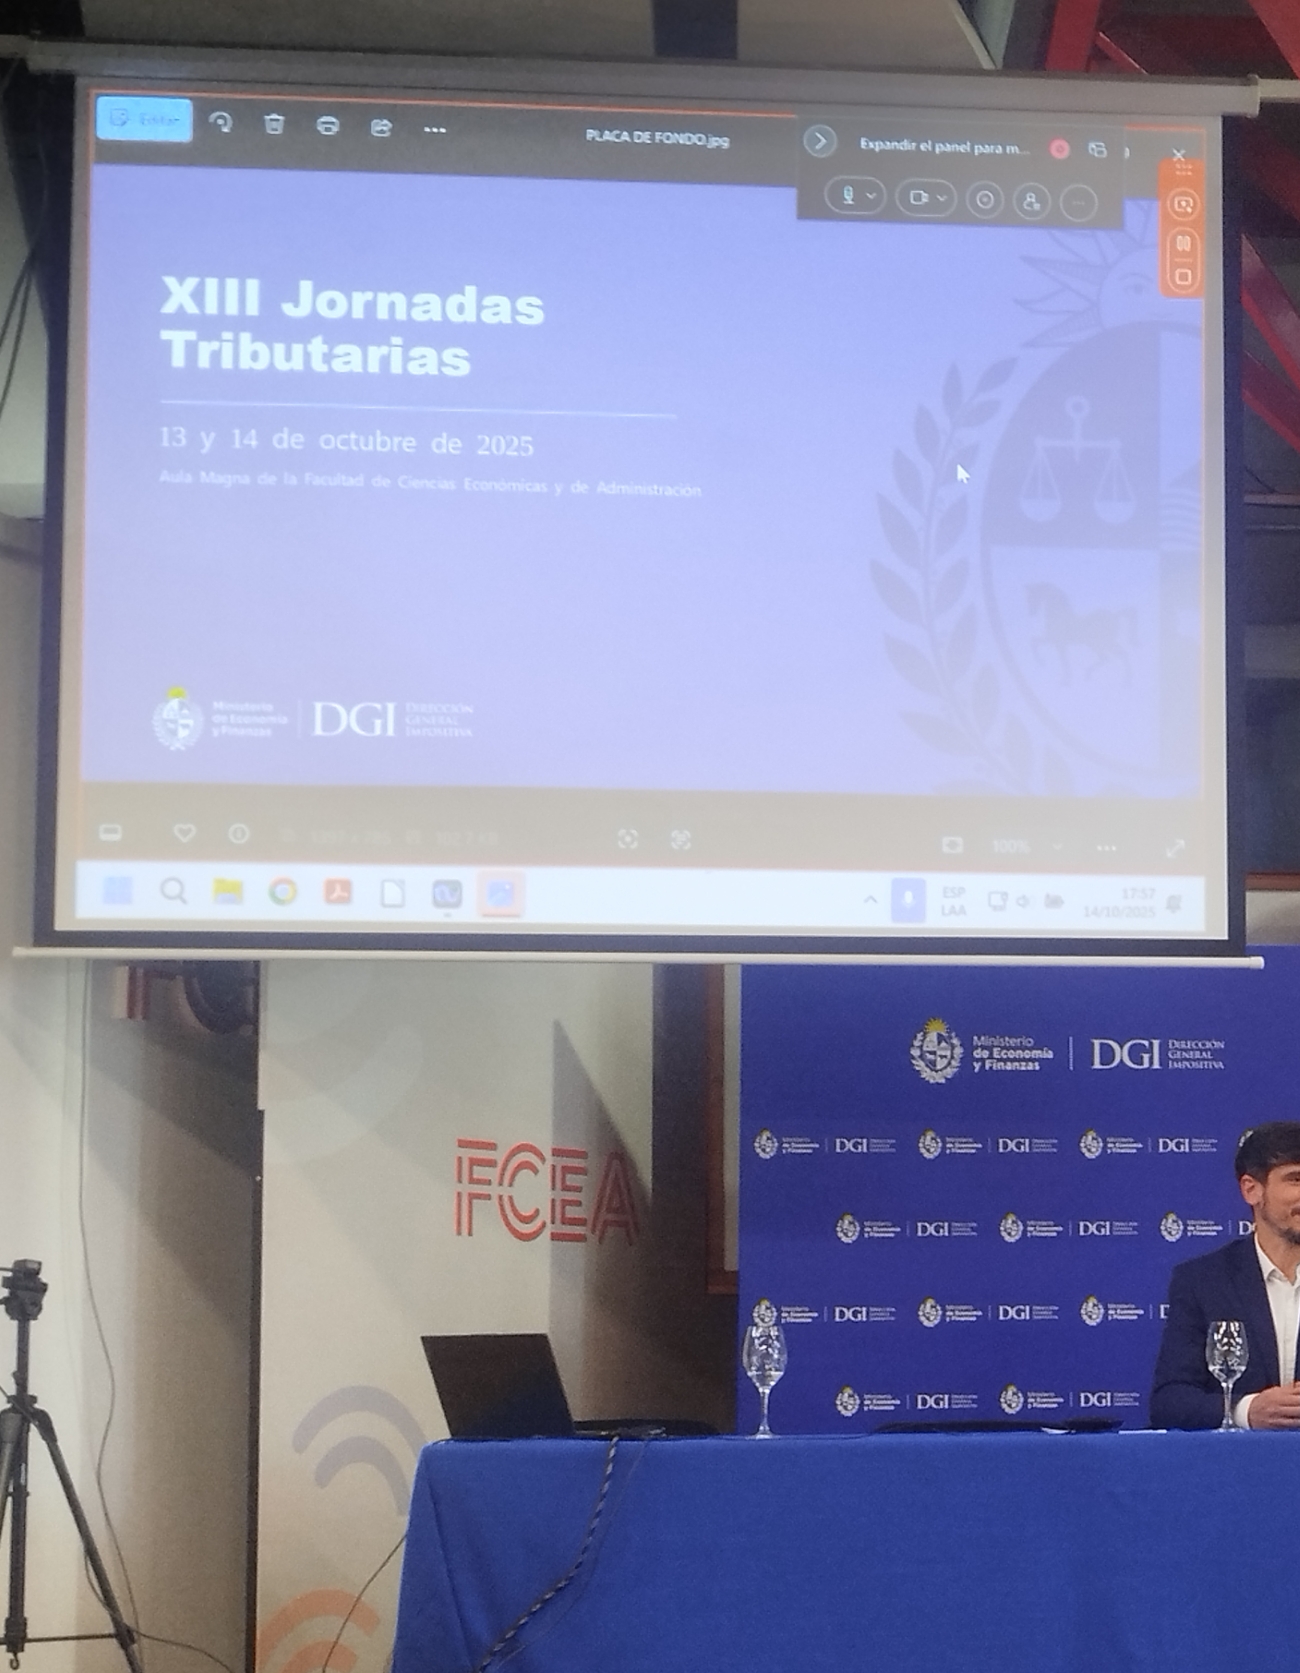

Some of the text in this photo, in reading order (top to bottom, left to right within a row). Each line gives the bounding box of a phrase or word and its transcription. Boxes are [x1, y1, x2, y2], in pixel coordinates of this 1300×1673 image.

[586, 129, 730, 149] PLACA DE FONDO.jpg
[860, 137, 916, 153] Expandir
[920, 140, 932, 152] el
[935, 141, 971, 154] panel
[974, 144, 1003, 156] para
[160, 276, 545, 326] XIII Jornadas
[160, 330, 472, 377] Tributarias
[160, 426, 534, 457] 13 y 14 de octubre de 2025
[158, 469, 701, 497] Aula Magna de la Facultad de Ciencias Económicas y de Administración
[213, 701, 274, 712] Ministerio
[212, 714, 228, 724] de
[312, 702, 398, 737] DGI
[221, 726, 272, 738] Finanzas
[942, 886, 966, 899] ESP
[1121, 887, 1156, 901] 17:57
[941, 904, 967, 917] LAA
[973, 1035, 1034, 1047] Ministerio
[973, 1047, 1054, 1058] de Economía
[1091, 1038, 1162, 1070] DGI
[973, 1059, 1040, 1073] y Finanzas
[836, 1139, 867, 1152] DGI
[999, 1139, 1029, 1152] DGI
[1159, 1139, 1189, 1152] DGI
[454, 1136, 642, 1246] FCEA
[917, 1222, 948, 1236] DGI
[1080, 1222, 1110, 1235] DGI
[835, 1307, 866, 1321] DGI
[999, 1306, 1029, 1320] DGI
[918, 1395, 949, 1409] DGI
[1080, 1392, 1111, 1407] DGI
